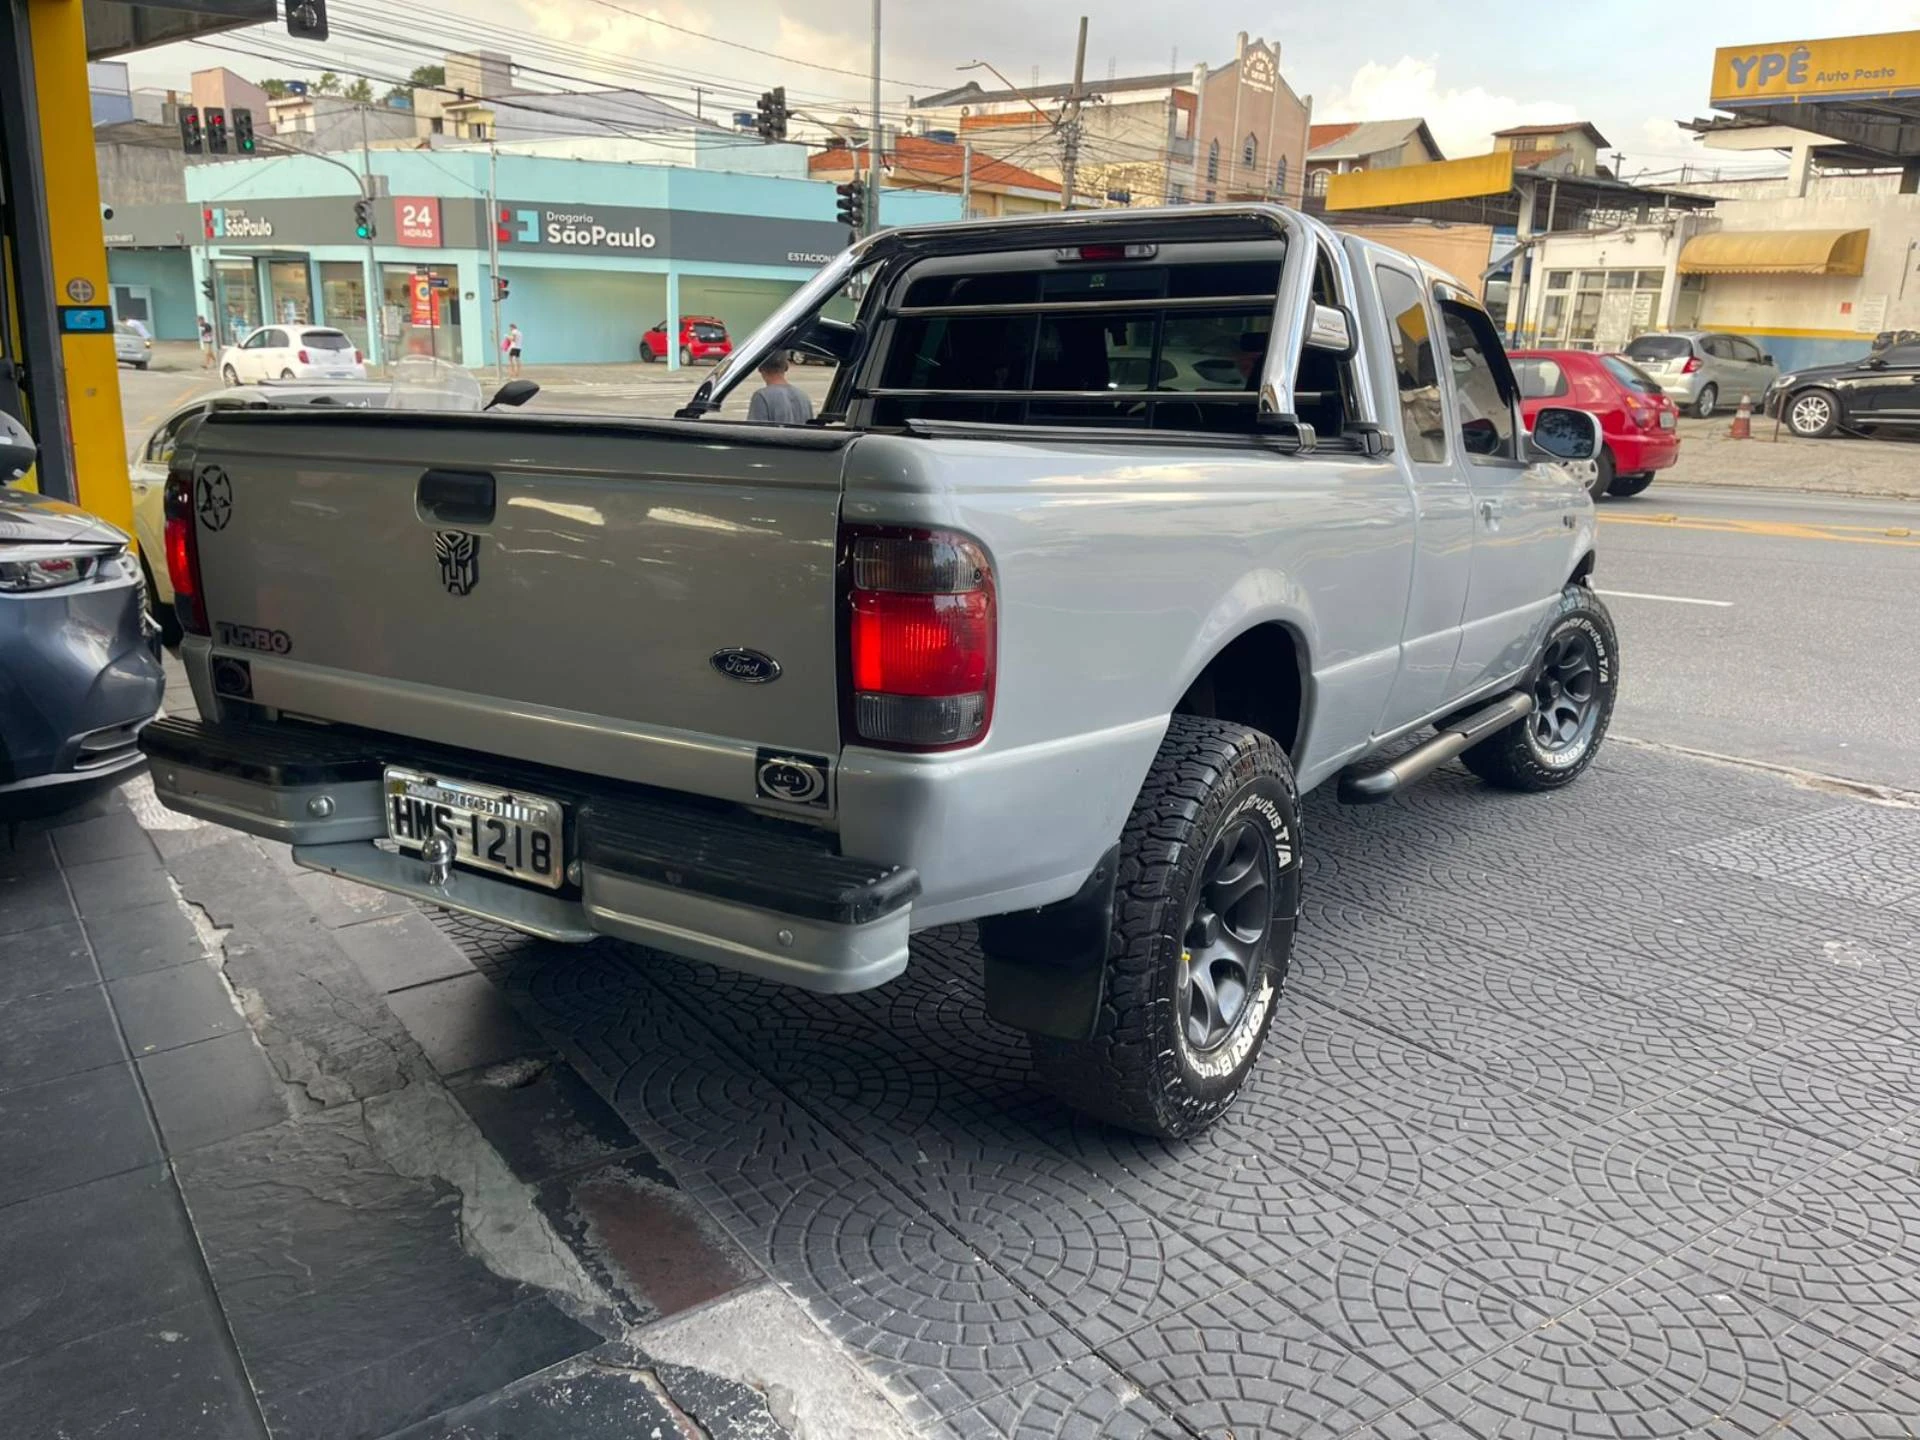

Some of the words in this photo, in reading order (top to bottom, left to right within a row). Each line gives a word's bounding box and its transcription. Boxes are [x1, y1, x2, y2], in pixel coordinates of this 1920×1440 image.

[1731, 46, 1811, 88] YPÊ
[1816, 70, 1850, 82] Auto
[1854, 67, 1895, 80] Posto
[403, 205, 432, 227] 24
[546, 211, 593, 225] Drogaria
[403, 228, 433, 239] HORAS
[547, 222, 656, 248] SãoPaulo
[215, 621, 292, 654] TURBO
[725, 653, 760, 677] Ford
